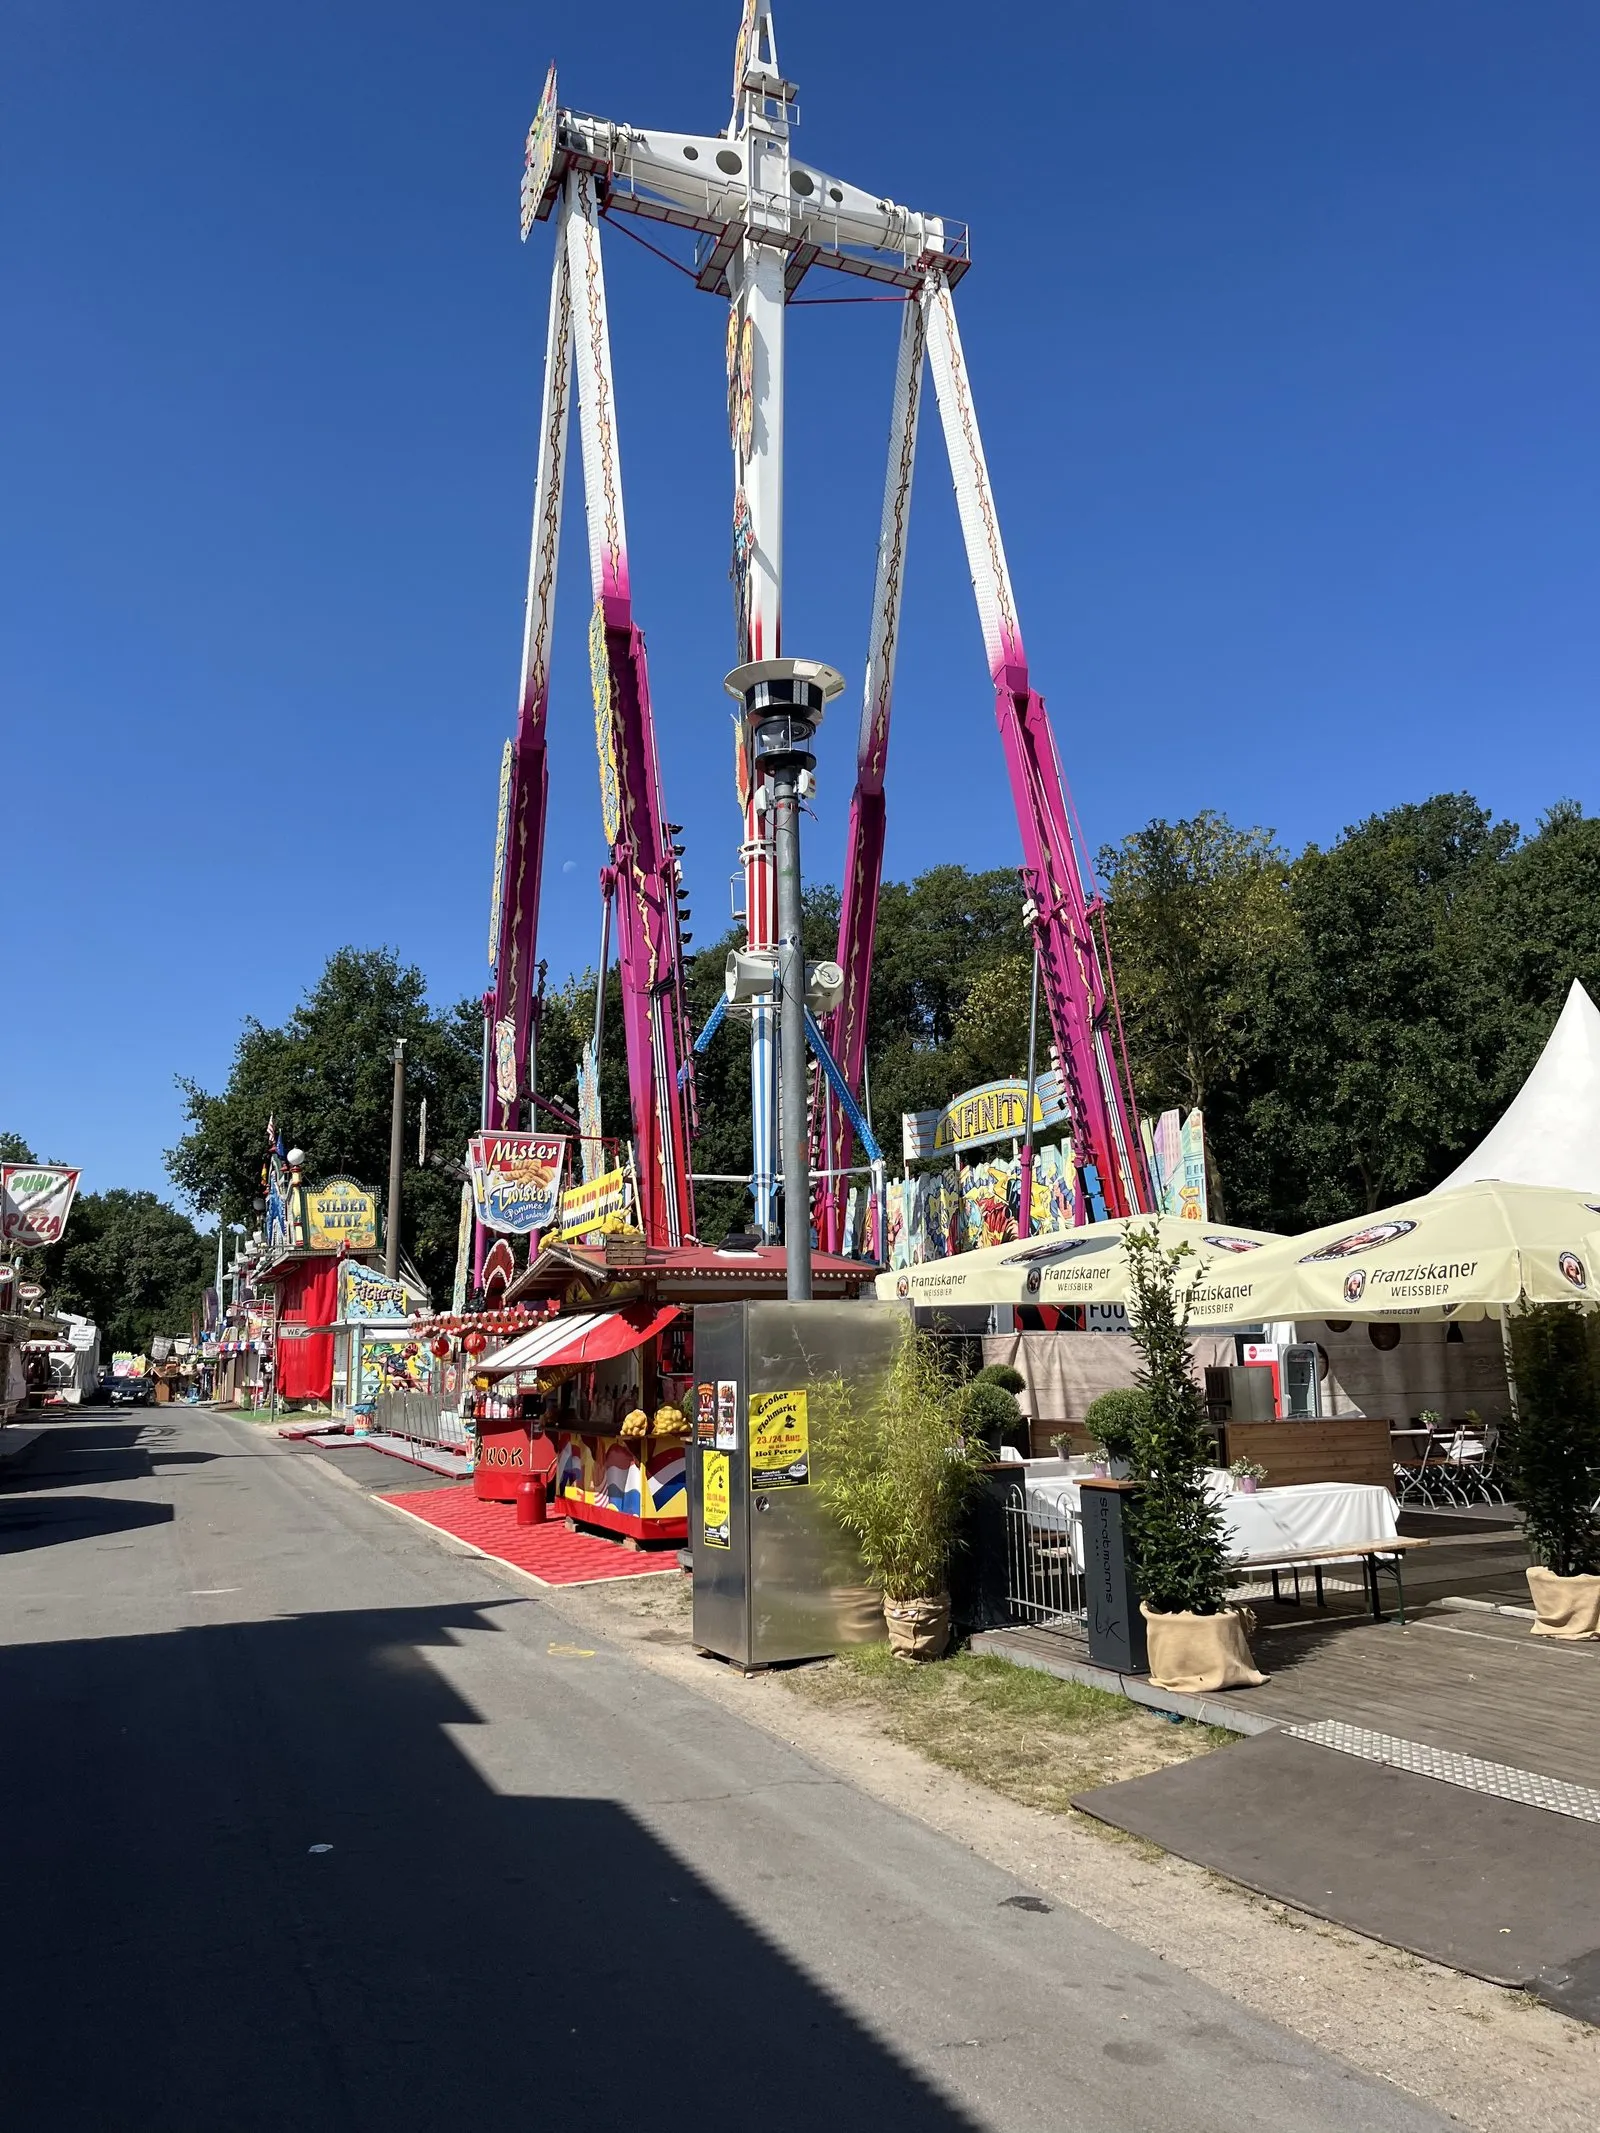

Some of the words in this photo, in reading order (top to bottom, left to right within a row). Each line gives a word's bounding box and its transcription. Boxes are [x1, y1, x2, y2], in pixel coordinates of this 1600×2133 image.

[486, 1140, 557, 1176] Mister
[488, 1181, 550, 1212] Twister
[317, 1198, 368, 1213] SILBER
[503, 1203, 544, 1221] Pommes
[6, 1213, 61, 1233] PIZZA
[323, 1214, 362, 1228] MINE
[911, 1273, 967, 1287] Franziskaner
[1044, 1267, 1111, 1283] Franziskaner
[1370, 1261, 1478, 1285] Franziskaner
[923, 1287, 953, 1297] WEISSBIER
[1058, 1282, 1093, 1292] WEISSBIER
[1390, 1284, 1449, 1297] WEISSBIER
[1192, 1303, 1234, 1316] WEISSBIER
[757, 1392, 789, 1416] Großer
[757, 1403, 797, 1435] Flohmarkt
[486, 1446, 525, 1468] WOK
[774, 1448, 802, 1456] Peters
[1099, 1496, 1113, 1604] stratmanns
